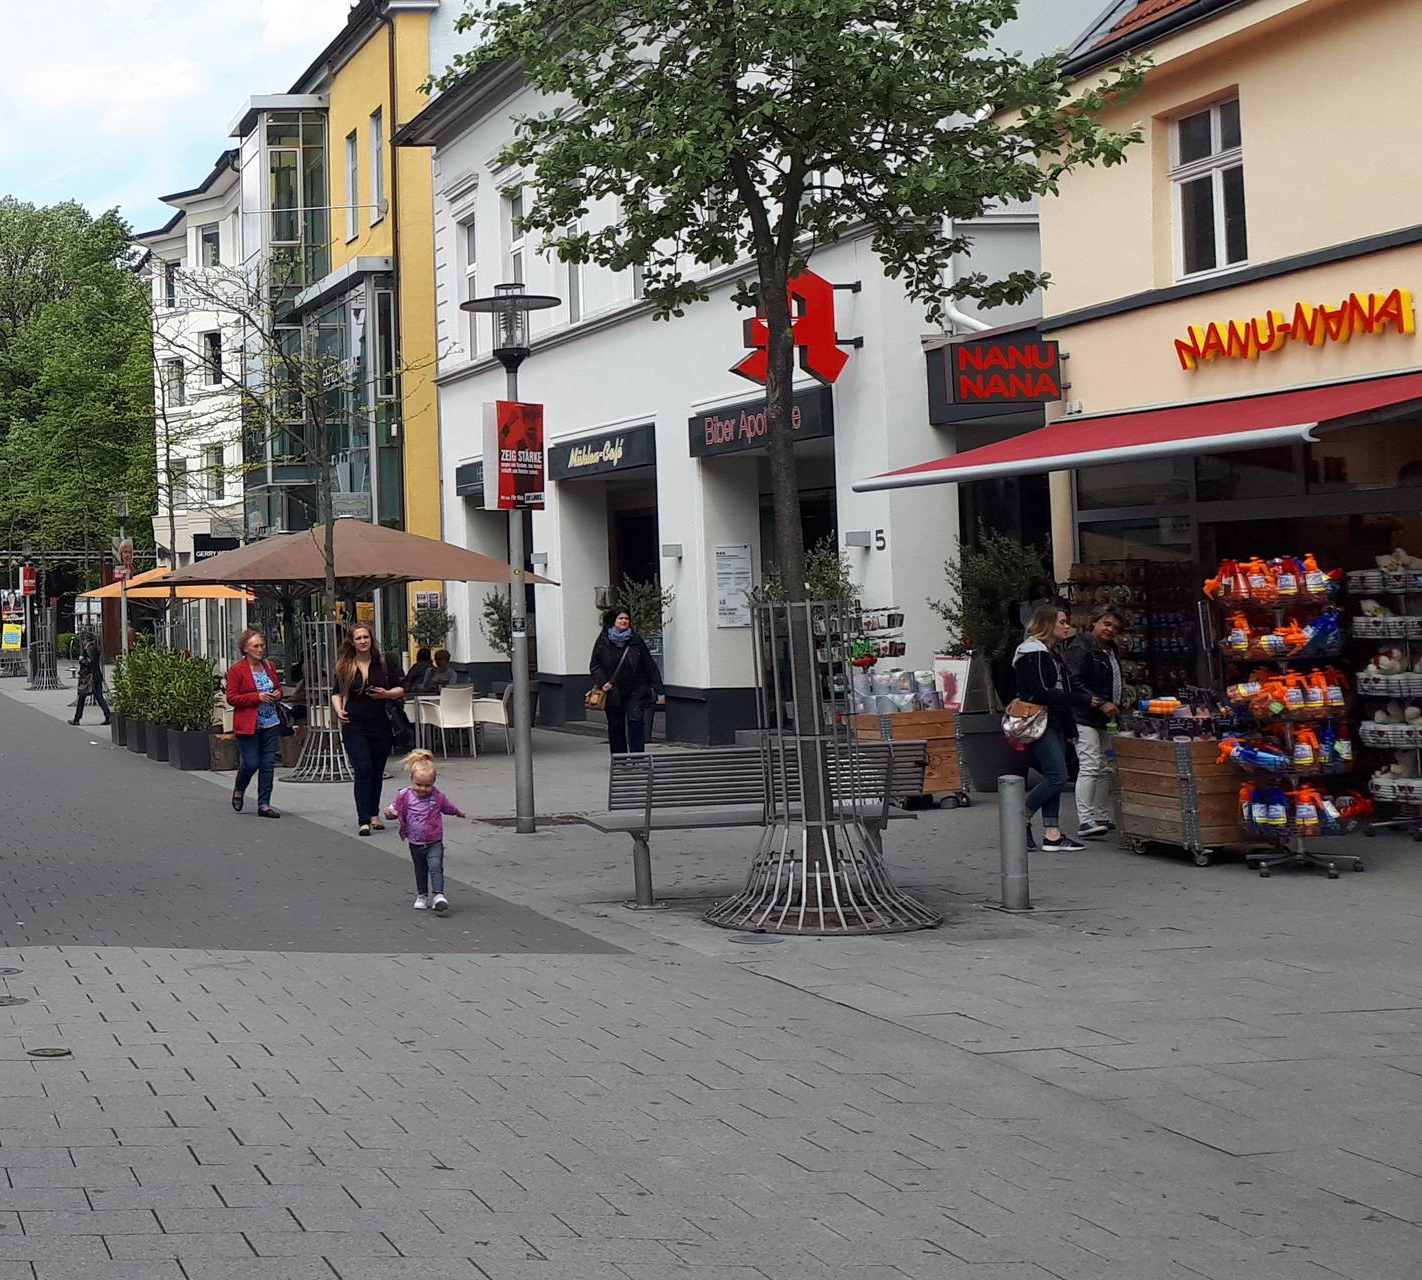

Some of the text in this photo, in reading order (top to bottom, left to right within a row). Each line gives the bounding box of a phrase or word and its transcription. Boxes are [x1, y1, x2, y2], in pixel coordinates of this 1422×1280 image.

[958, 344, 1056, 371] NANU
[960, 373, 1059, 399] NANA
[705, 415, 735, 445] Biber
[500, 449, 542, 463] ZEIG STÄRKE
[875, 529, 886, 551] 5
